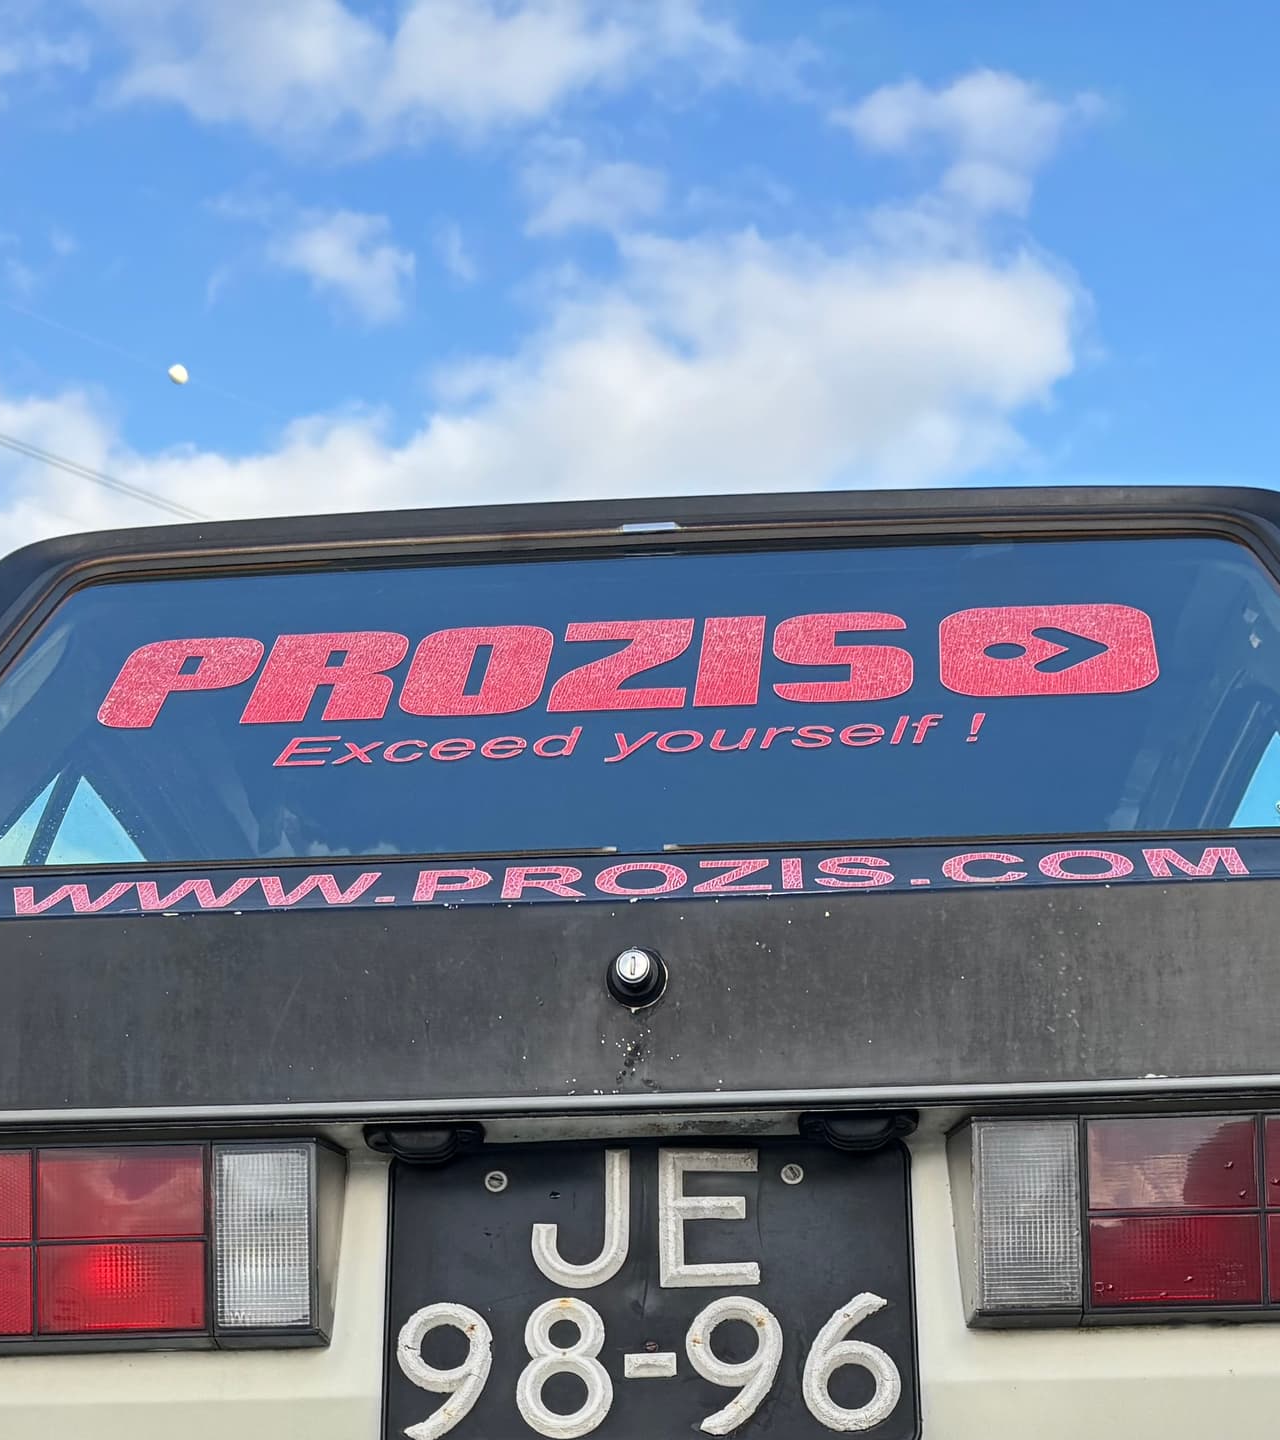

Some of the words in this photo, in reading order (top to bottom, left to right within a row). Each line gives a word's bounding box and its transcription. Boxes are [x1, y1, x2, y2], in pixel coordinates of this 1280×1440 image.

[96, 610, 915, 730] PROZIS
[271, 726, 584, 768] Exceed
[603, 713, 944, 763] yourself
[13, 847, 1250, 916] WWW.PROZIS.COM
[530, 1147, 762, 1290] JE
